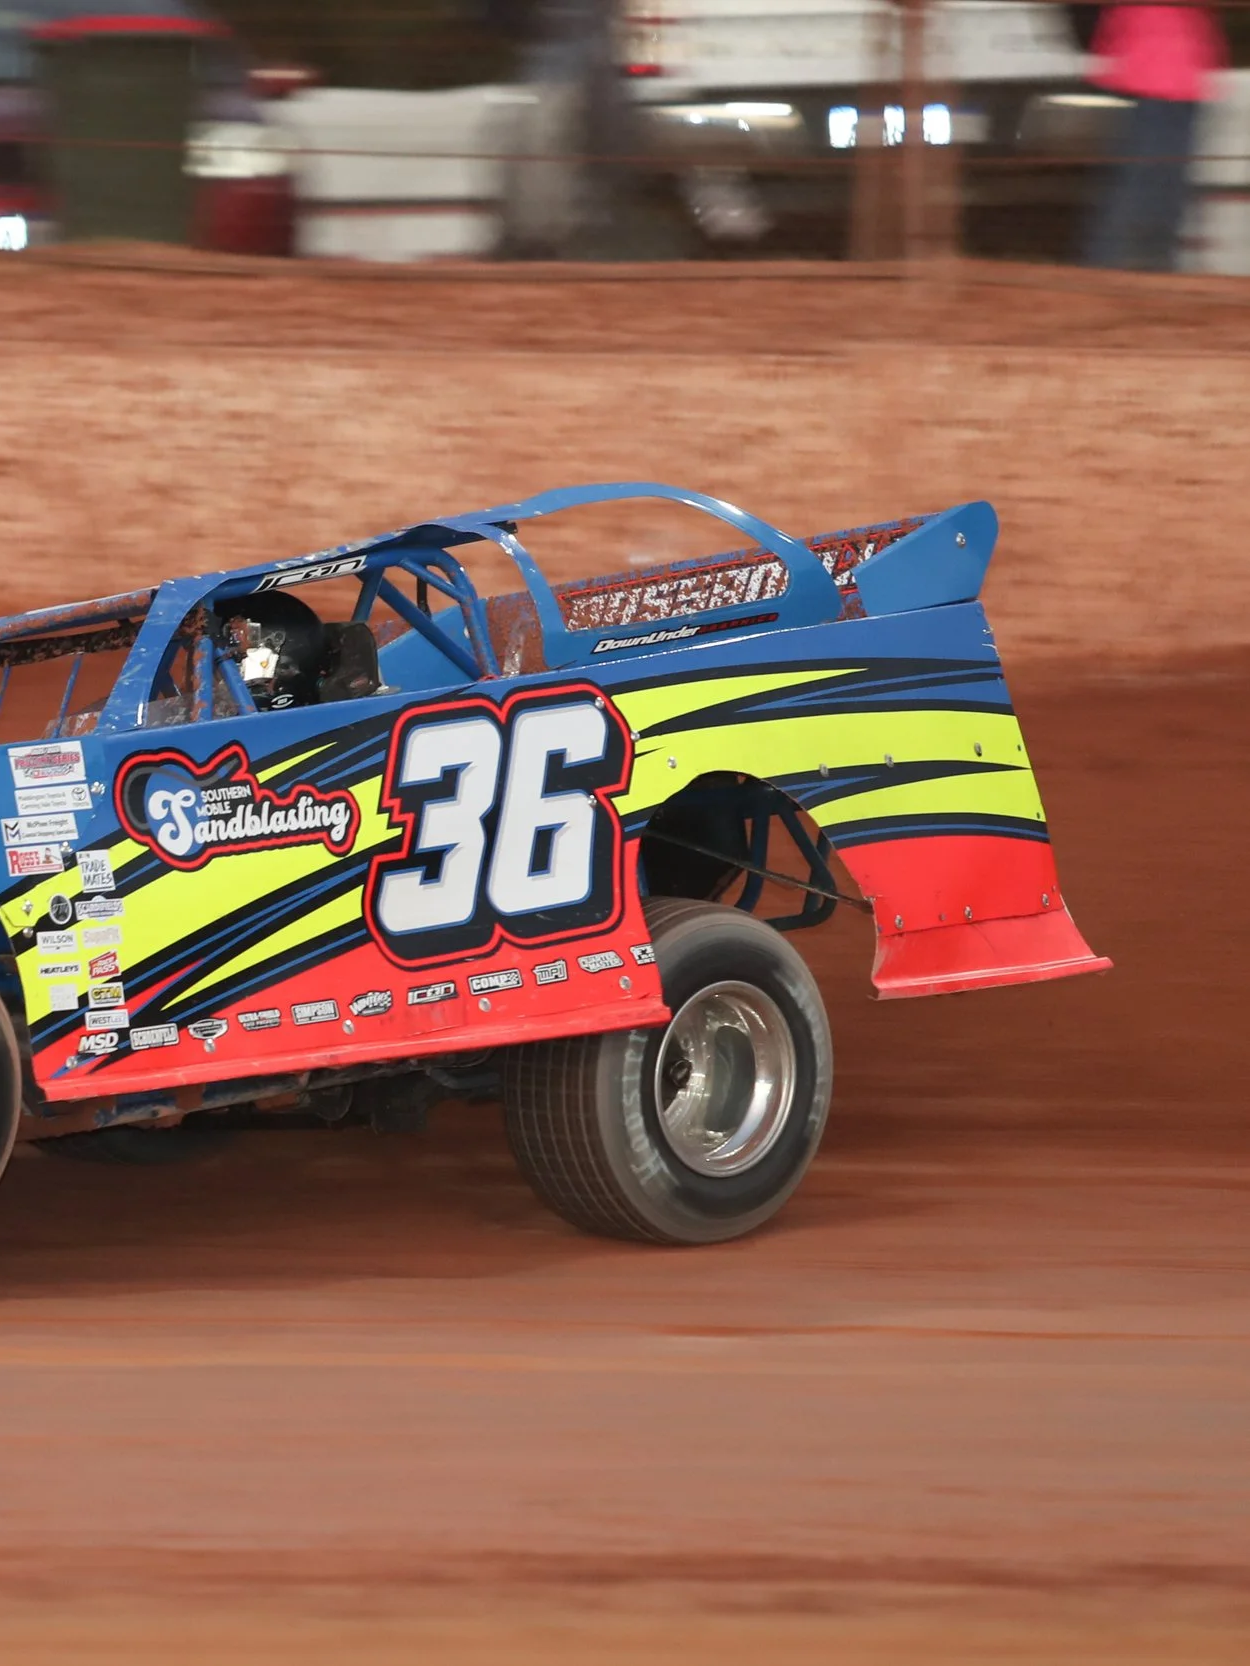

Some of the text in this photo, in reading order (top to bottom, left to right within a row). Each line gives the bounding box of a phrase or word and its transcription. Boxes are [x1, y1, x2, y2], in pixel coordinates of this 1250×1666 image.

[593, 624, 700, 653] DownUnder
[200, 784, 252, 802] SOUTHERN
[196, 801, 233, 817] MOBILE
[148, 788, 350, 856] Sandblasting
[378, 702, 607, 935] 36
[80, 859, 107, 874] TRADE
[83, 872, 113, 886] MATES
[40, 934, 74, 945] WILSON
[40, 964, 80, 975] HEATLEYS
[294, 1002, 334, 1018] SIMPSON
[78, 1031, 119, 1053] MSD
